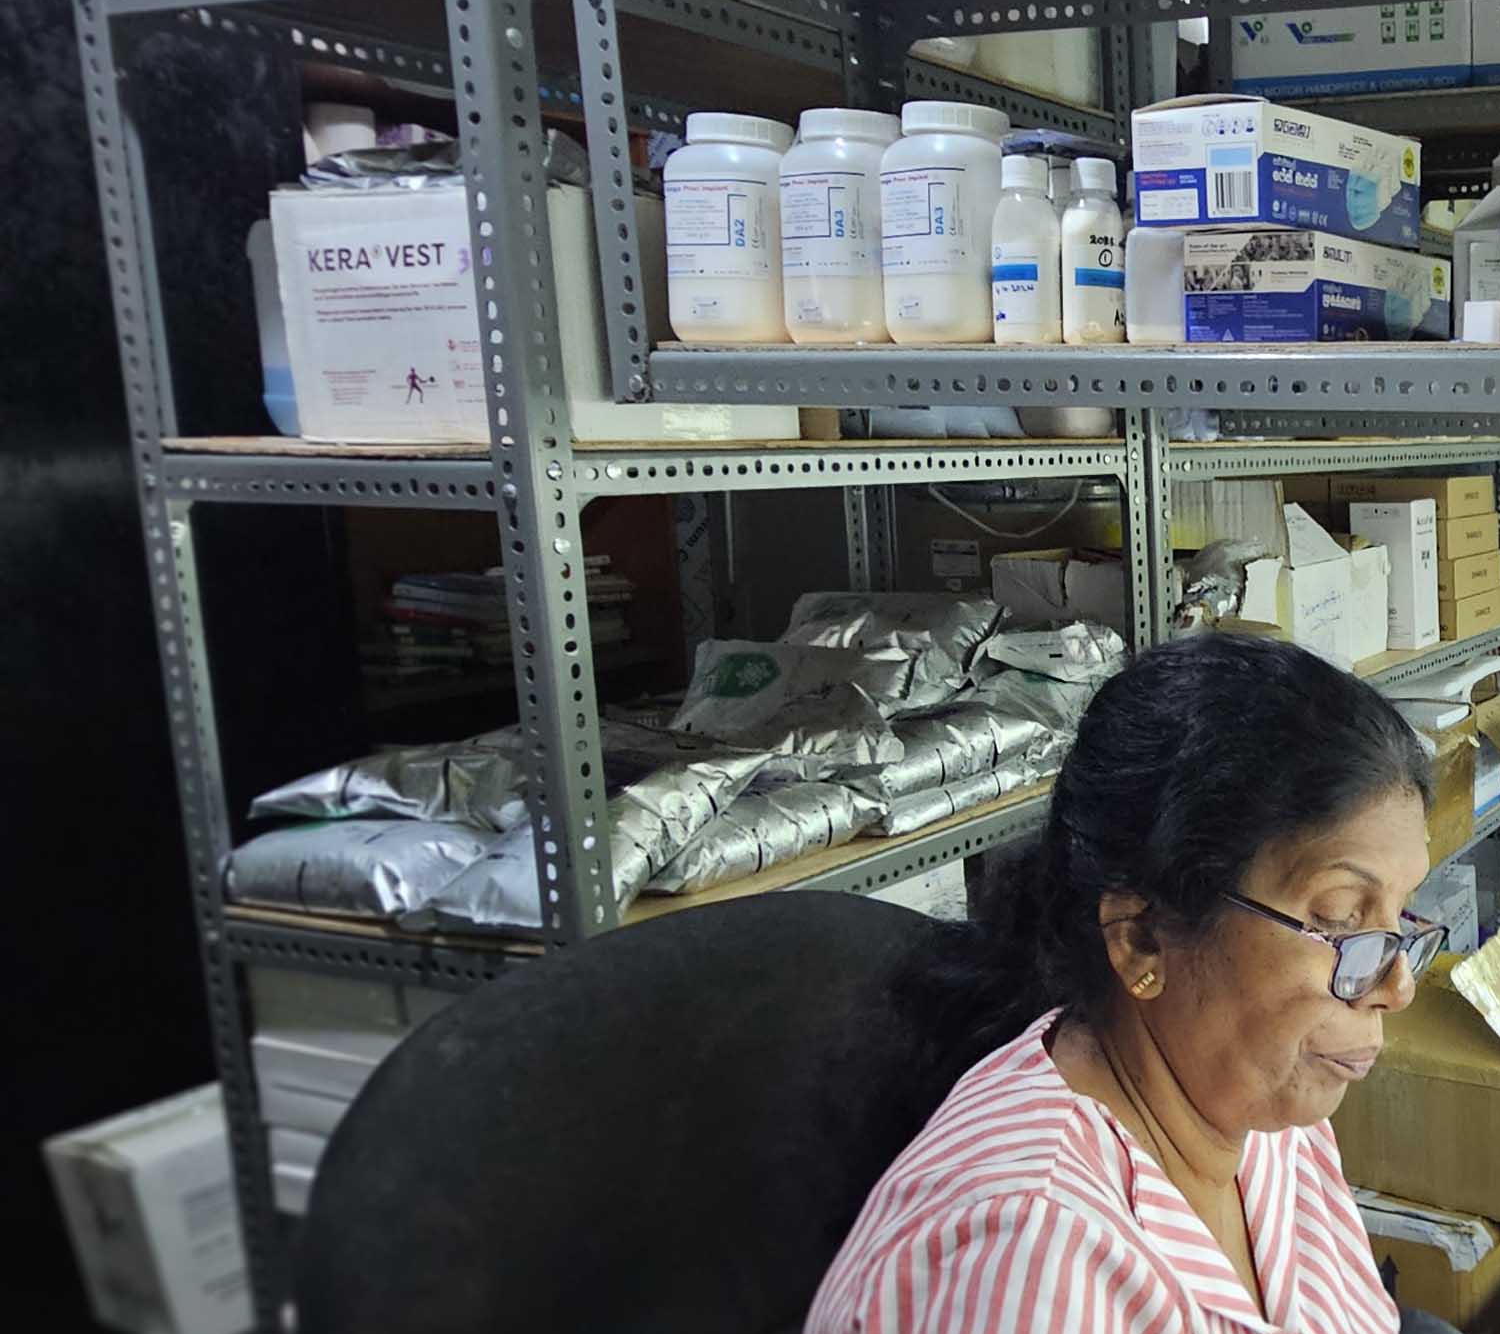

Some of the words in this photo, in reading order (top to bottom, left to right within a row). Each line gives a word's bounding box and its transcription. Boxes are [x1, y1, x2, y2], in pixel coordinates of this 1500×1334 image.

[735, 219, 746, 248] DA2
[834, 210, 845, 238] DA3
[935, 207, 945, 236] DA3
[308, 246, 372, 273] KERA
[385, 242, 446, 268] VEST
